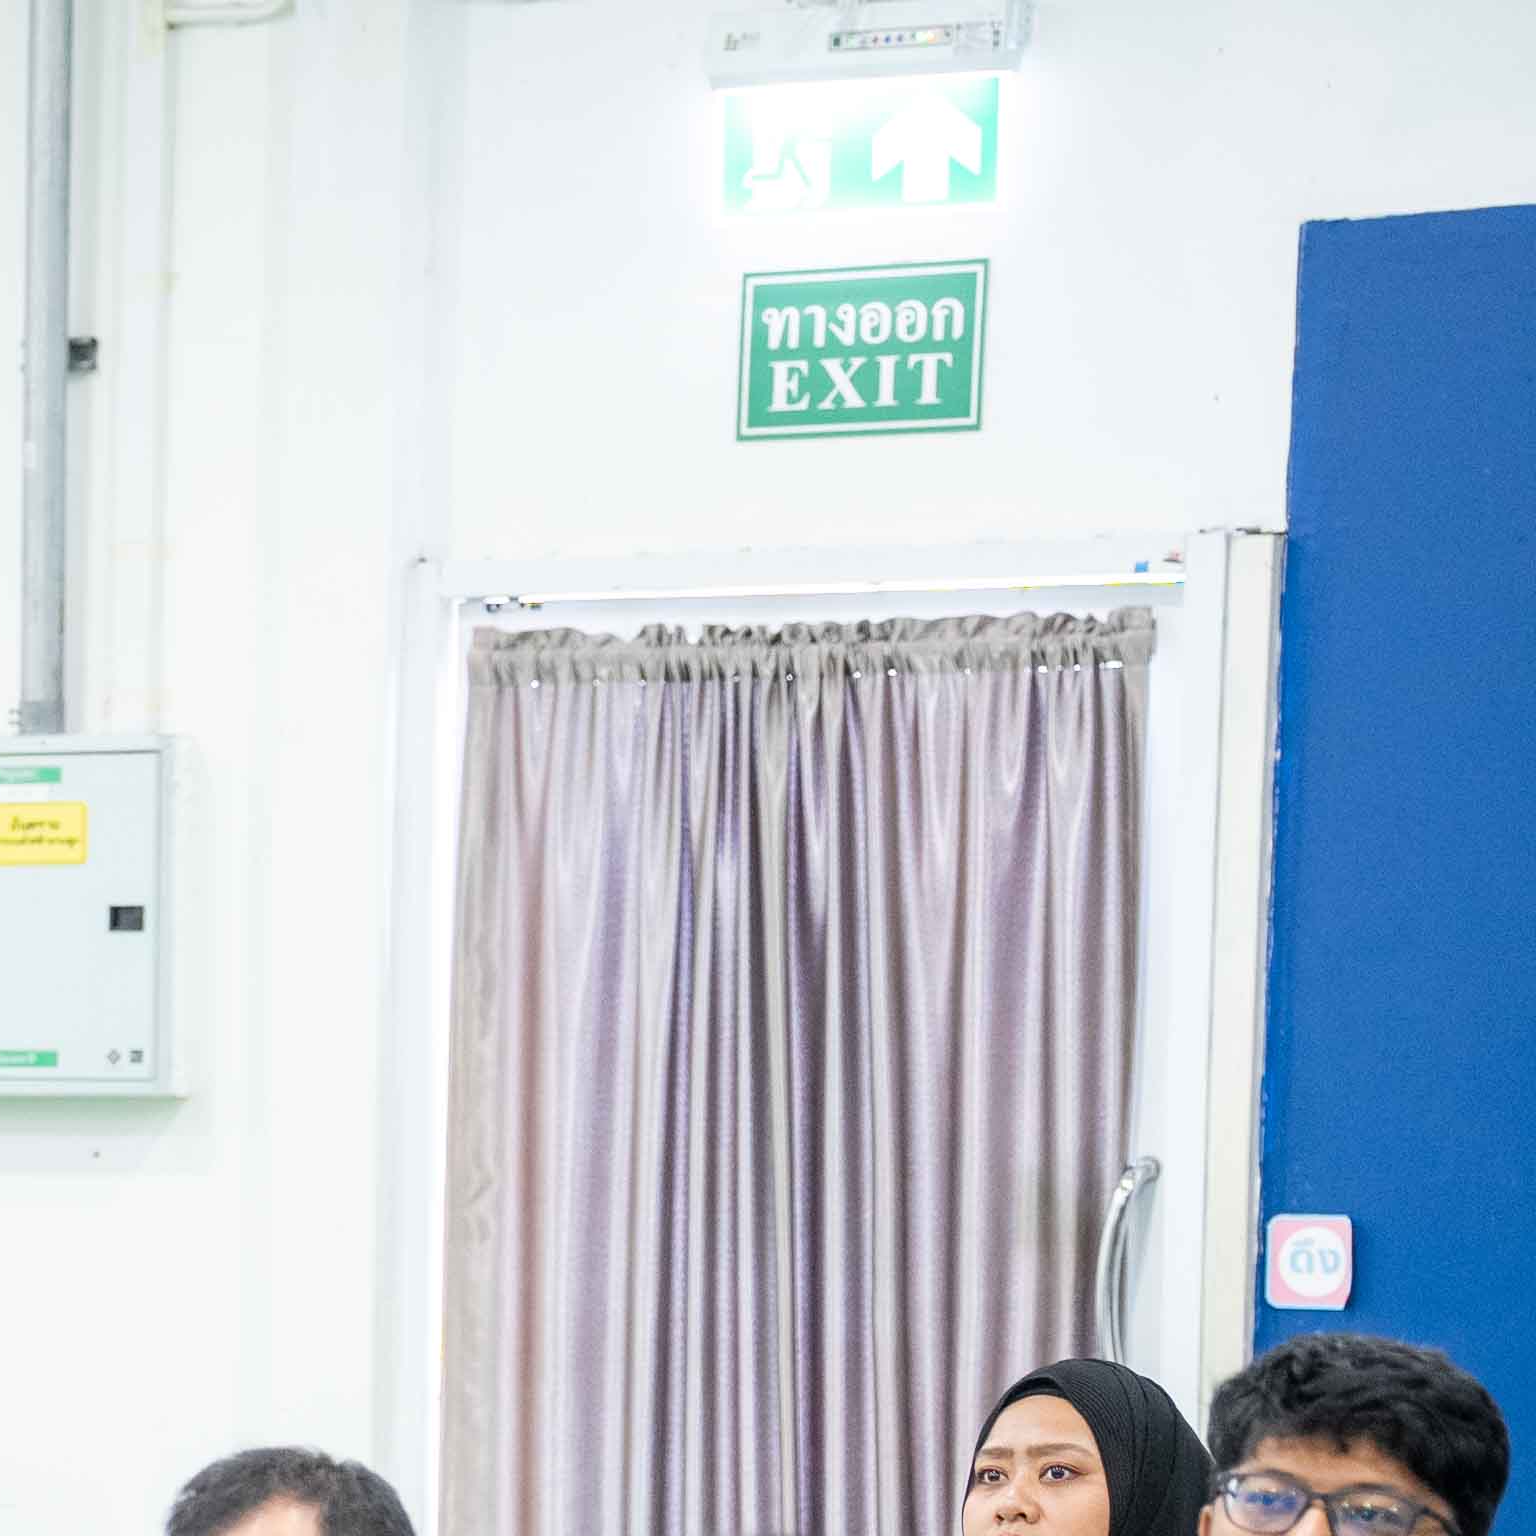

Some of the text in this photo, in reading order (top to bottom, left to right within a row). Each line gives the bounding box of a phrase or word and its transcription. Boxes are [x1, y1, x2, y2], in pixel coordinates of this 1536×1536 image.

[760, 297, 966, 350] ทางออก
[766, 351, 955, 413] EXIT
